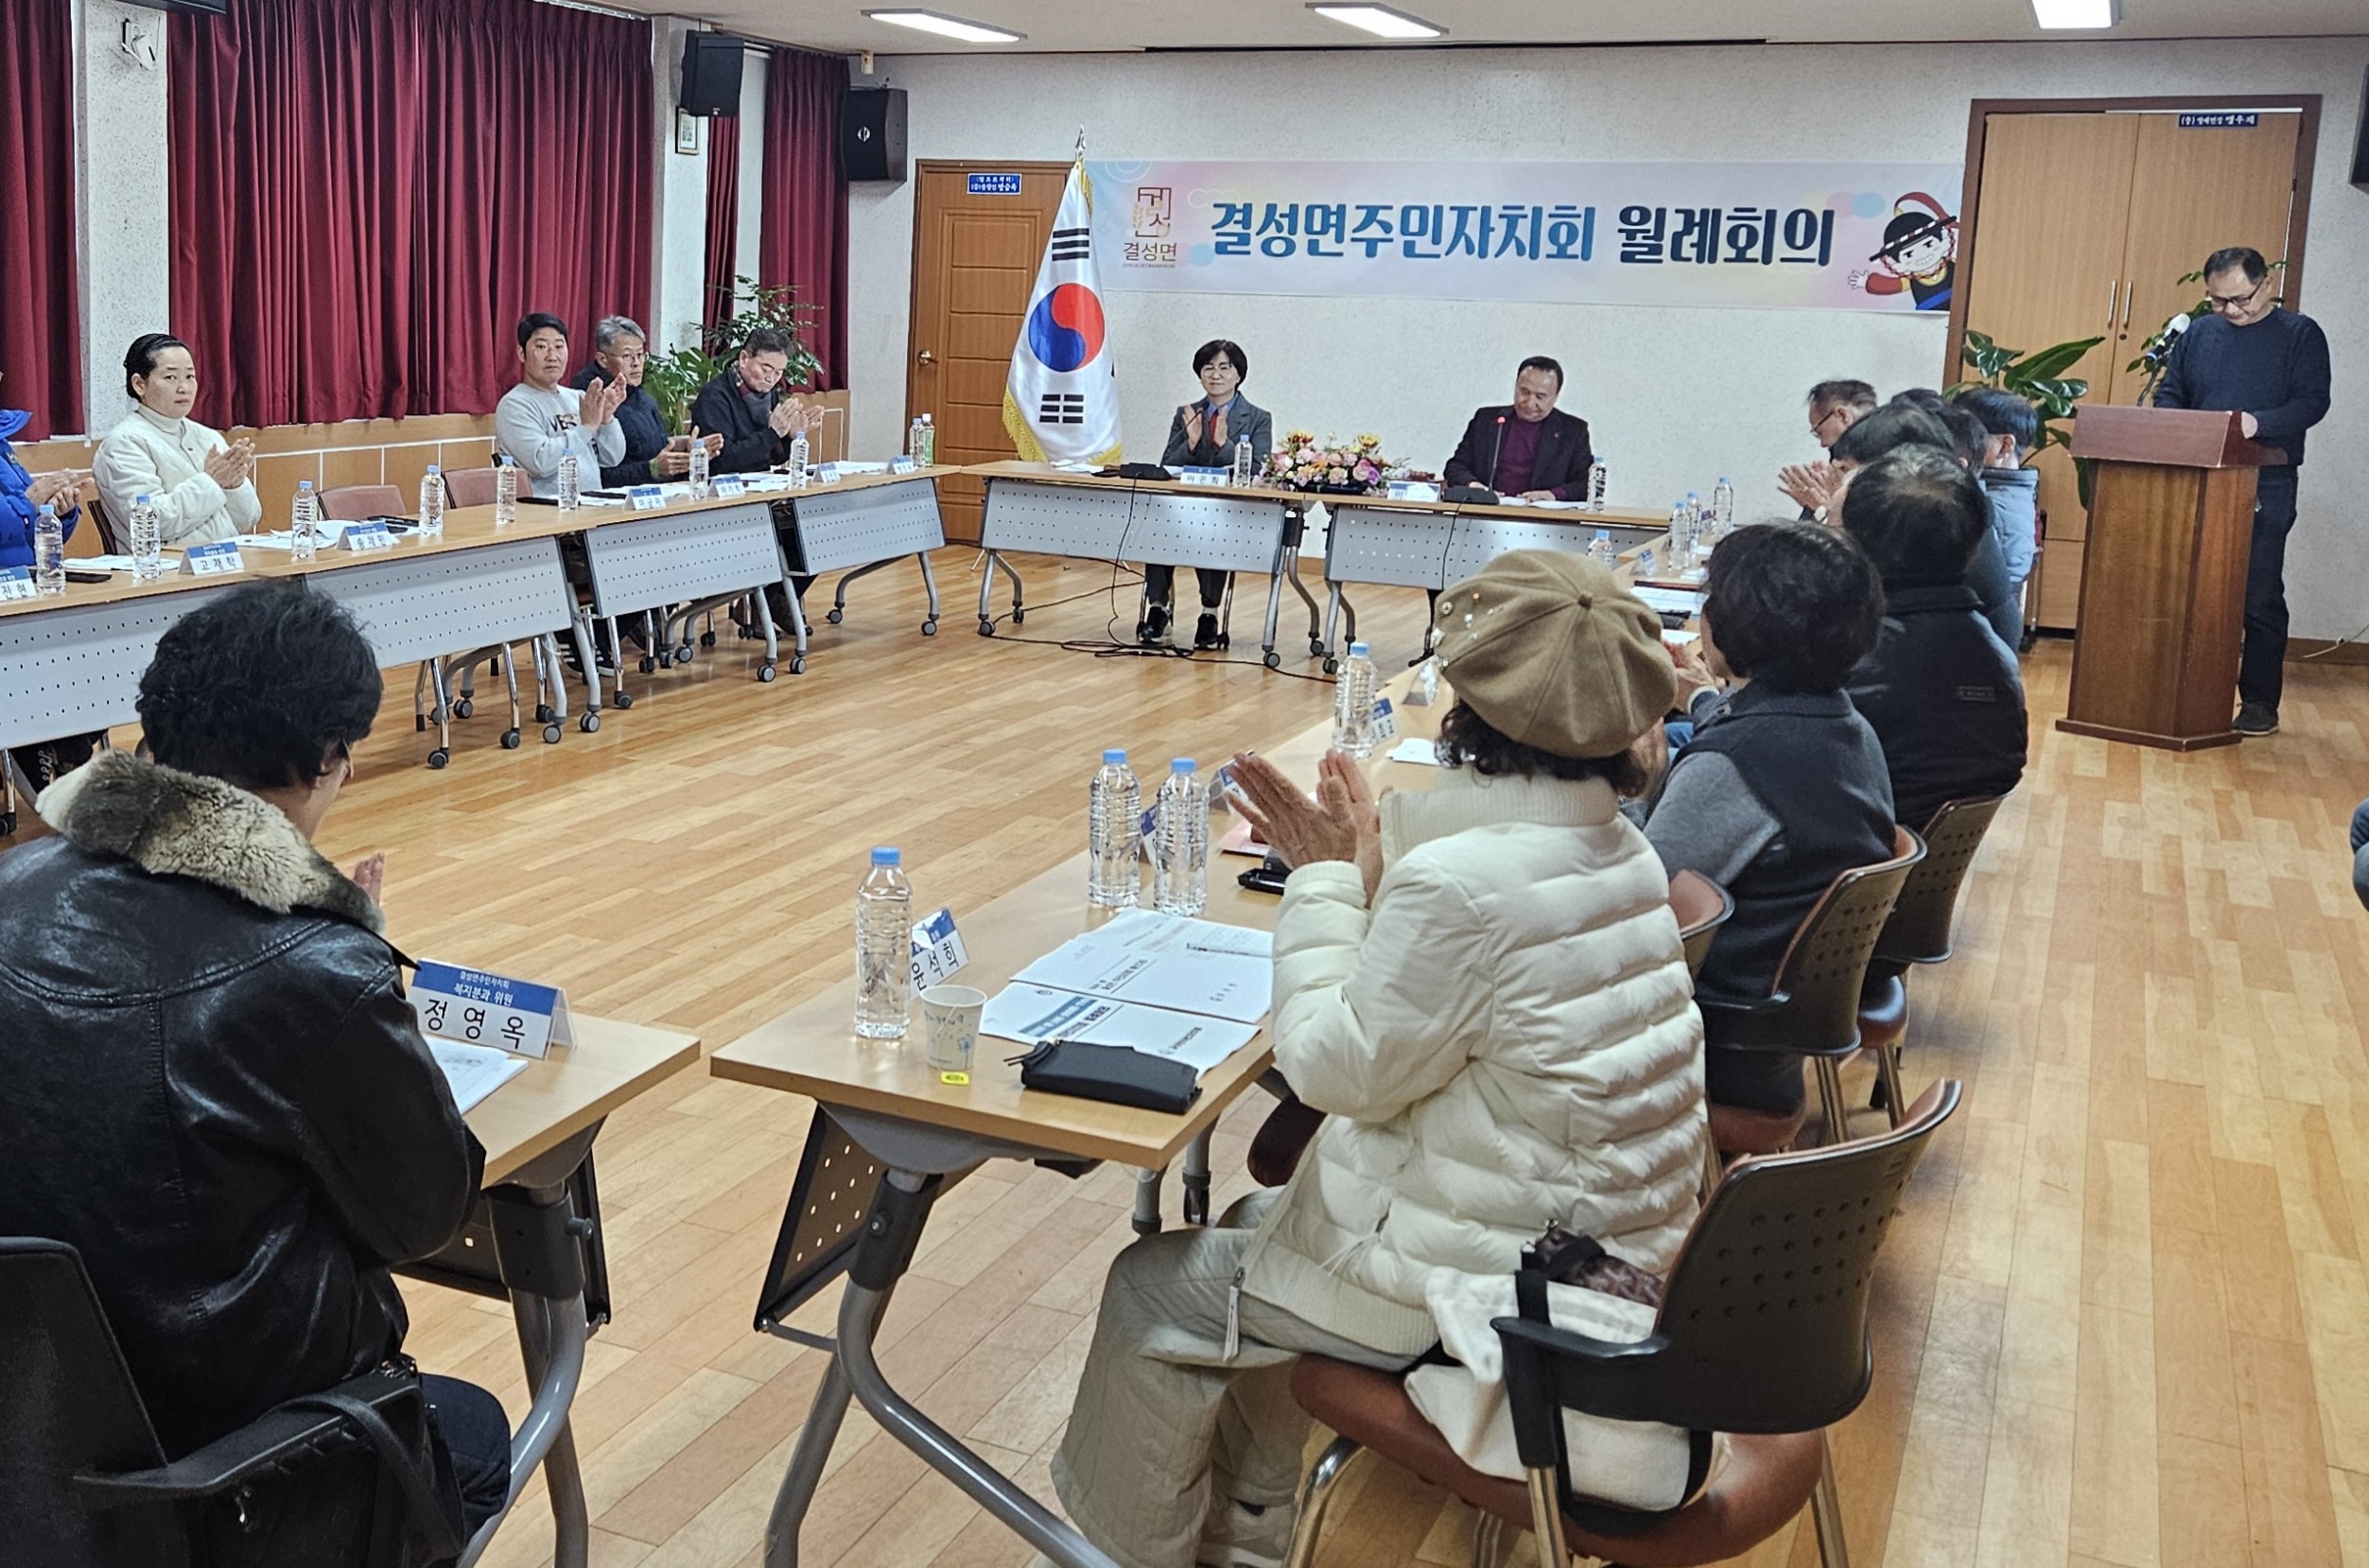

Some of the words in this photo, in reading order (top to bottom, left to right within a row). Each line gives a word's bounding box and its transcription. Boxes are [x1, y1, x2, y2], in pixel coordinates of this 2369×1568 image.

[1211, 201, 1595, 261] 결성면주민자치회
[1617, 205, 1835, 267] 월례회의
[1124, 242, 1177, 262] 결성면
[494, 991, 514, 1007] 위원
